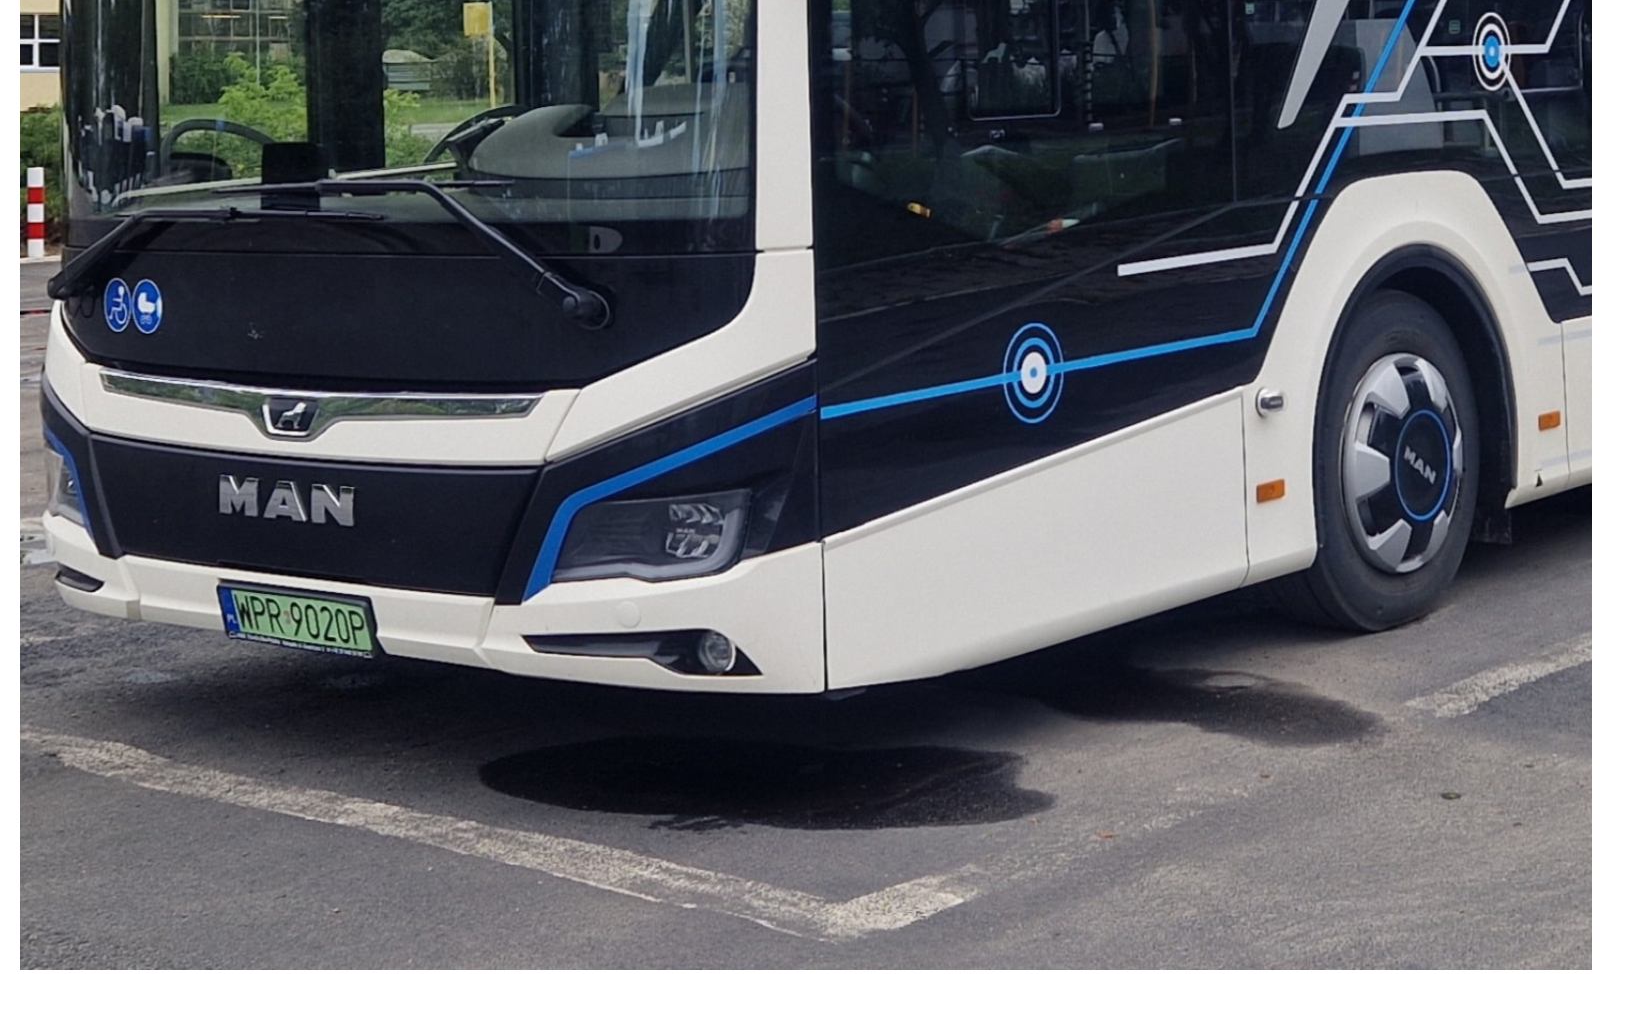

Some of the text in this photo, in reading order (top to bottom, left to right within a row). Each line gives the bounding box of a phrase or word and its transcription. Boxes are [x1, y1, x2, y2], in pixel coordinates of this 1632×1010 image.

[1403, 445, 1437, 485] MAN
[219, 474, 356, 527] MAN
[234, 593, 286, 635] WPR
[289, 601, 365, 646] 9020P
